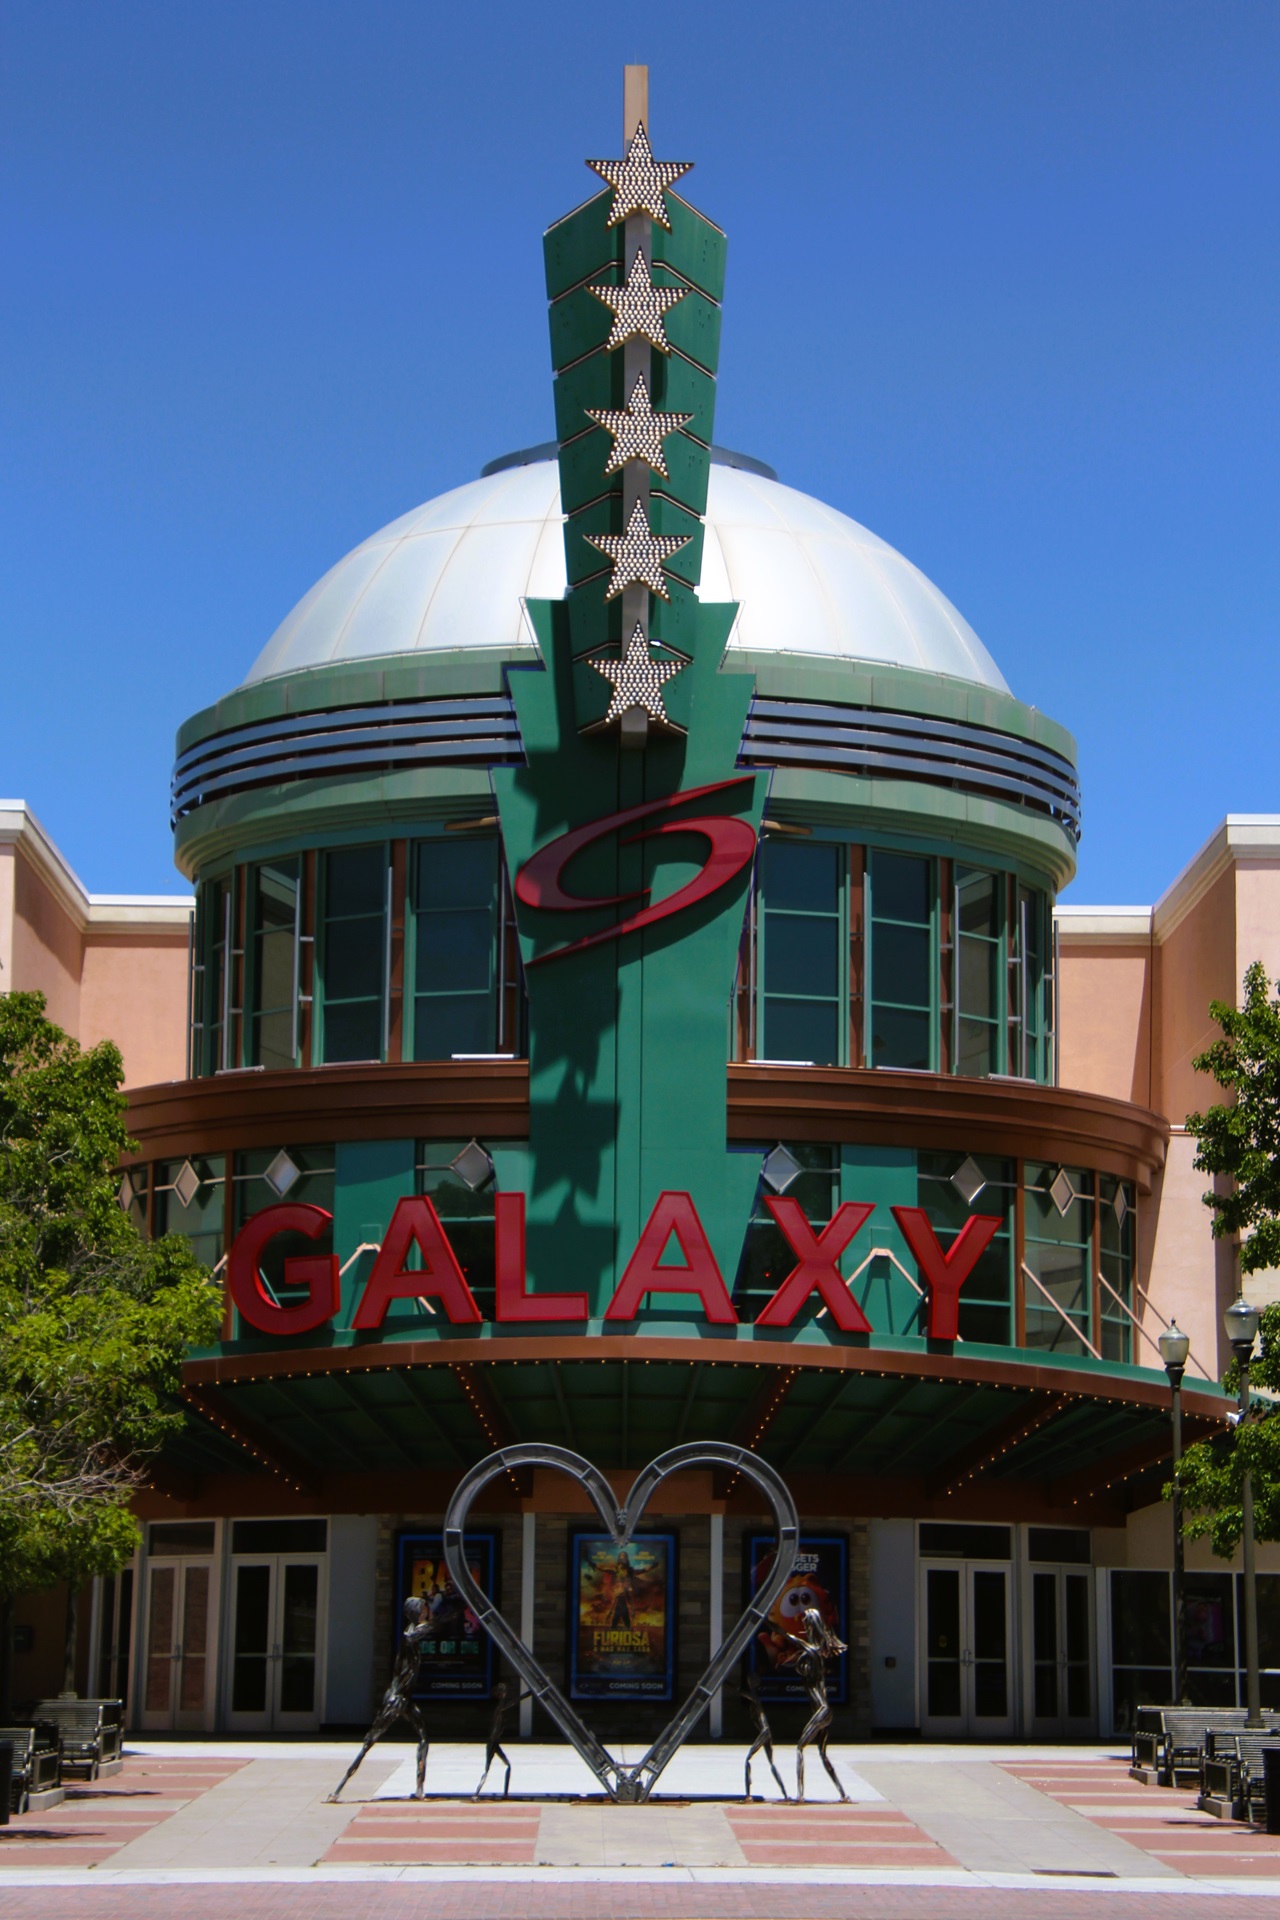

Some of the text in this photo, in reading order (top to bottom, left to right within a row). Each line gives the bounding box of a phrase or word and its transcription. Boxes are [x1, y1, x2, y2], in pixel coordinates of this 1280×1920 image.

[228, 1190, 1004, 1341] GALAXY
[593, 1631, 650, 1646] FURIOSA
[608, 1682, 640, 1690] COMING
[641, 1682, 664, 1690] SOON
